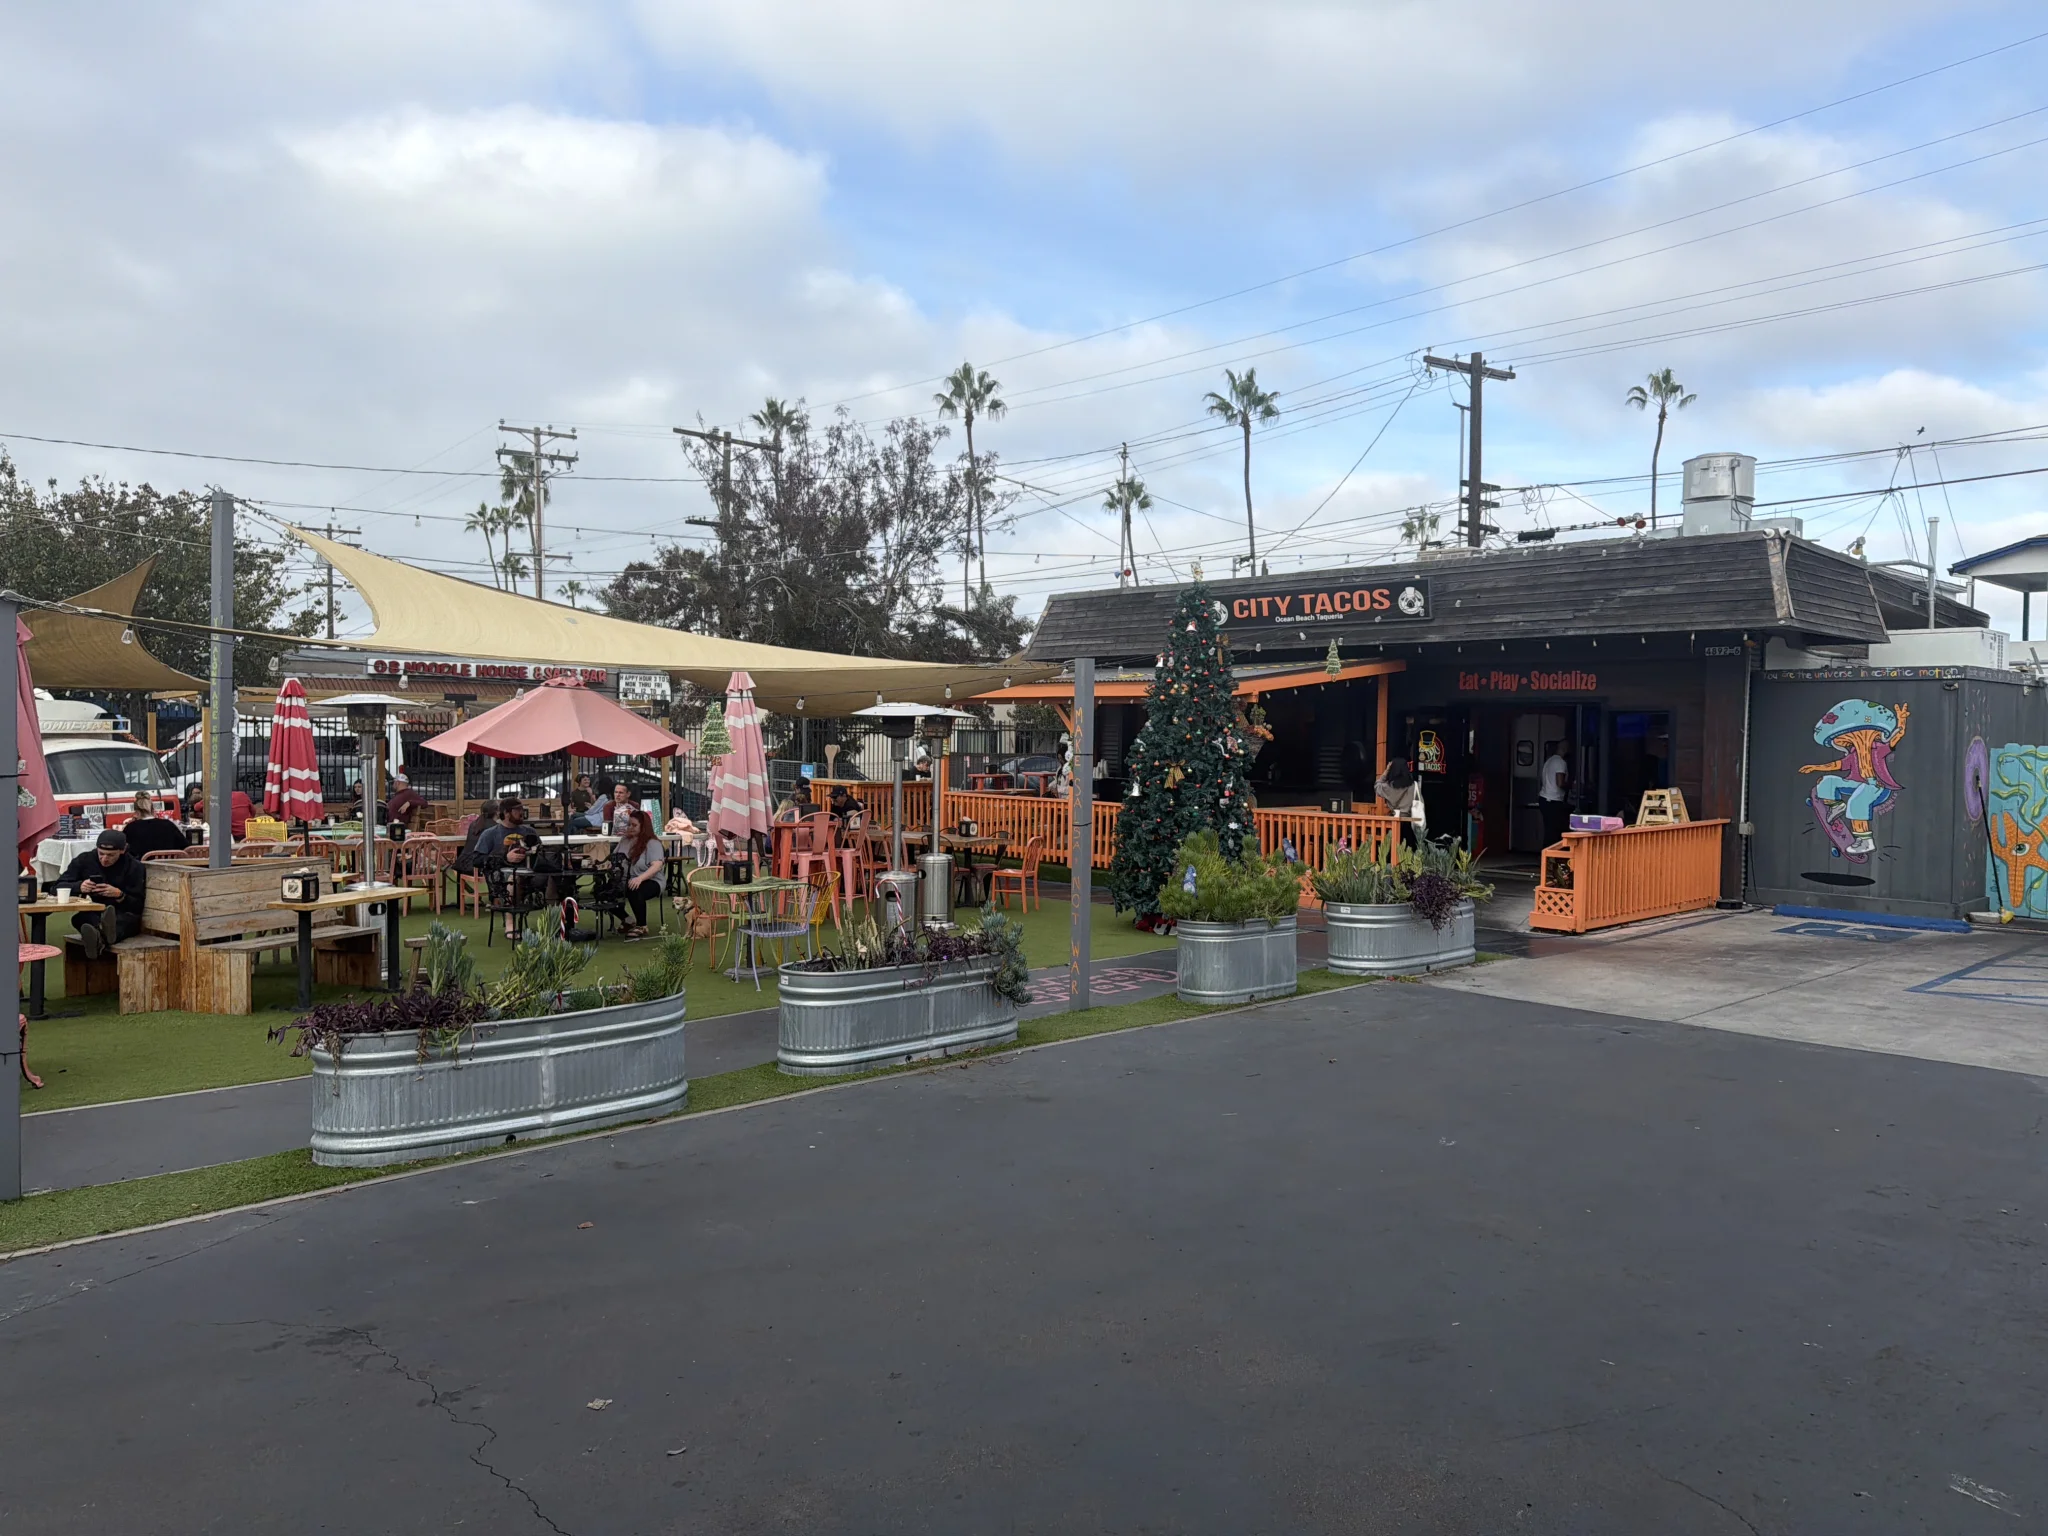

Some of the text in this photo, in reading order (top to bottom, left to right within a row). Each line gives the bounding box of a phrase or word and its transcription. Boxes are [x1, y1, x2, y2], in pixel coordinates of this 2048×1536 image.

[1233, 588, 1391, 618] CITY TACOS
[1275, 612, 1344, 623] Ocean Beach Taqueria
[211, 645, 219, 686] ALONE
[374, 660, 401, 674] OB
[404, 661, 472, 677] NOODLE
[476, 664, 529, 679] HOUSE
[533, 666, 542, 680] &
[581, 668, 608, 682] BAR
[1782, 670, 1796, 679] are
[1814, 669, 1853, 679] universe
[1919, 667, 1959, 679] motion
[1459, 670, 1597, 692] Eat Play Socialize
[210, 726, 219, 781] ENOUGH
[1070, 706, 1083, 994] MAKE SALSA NOT WAR
